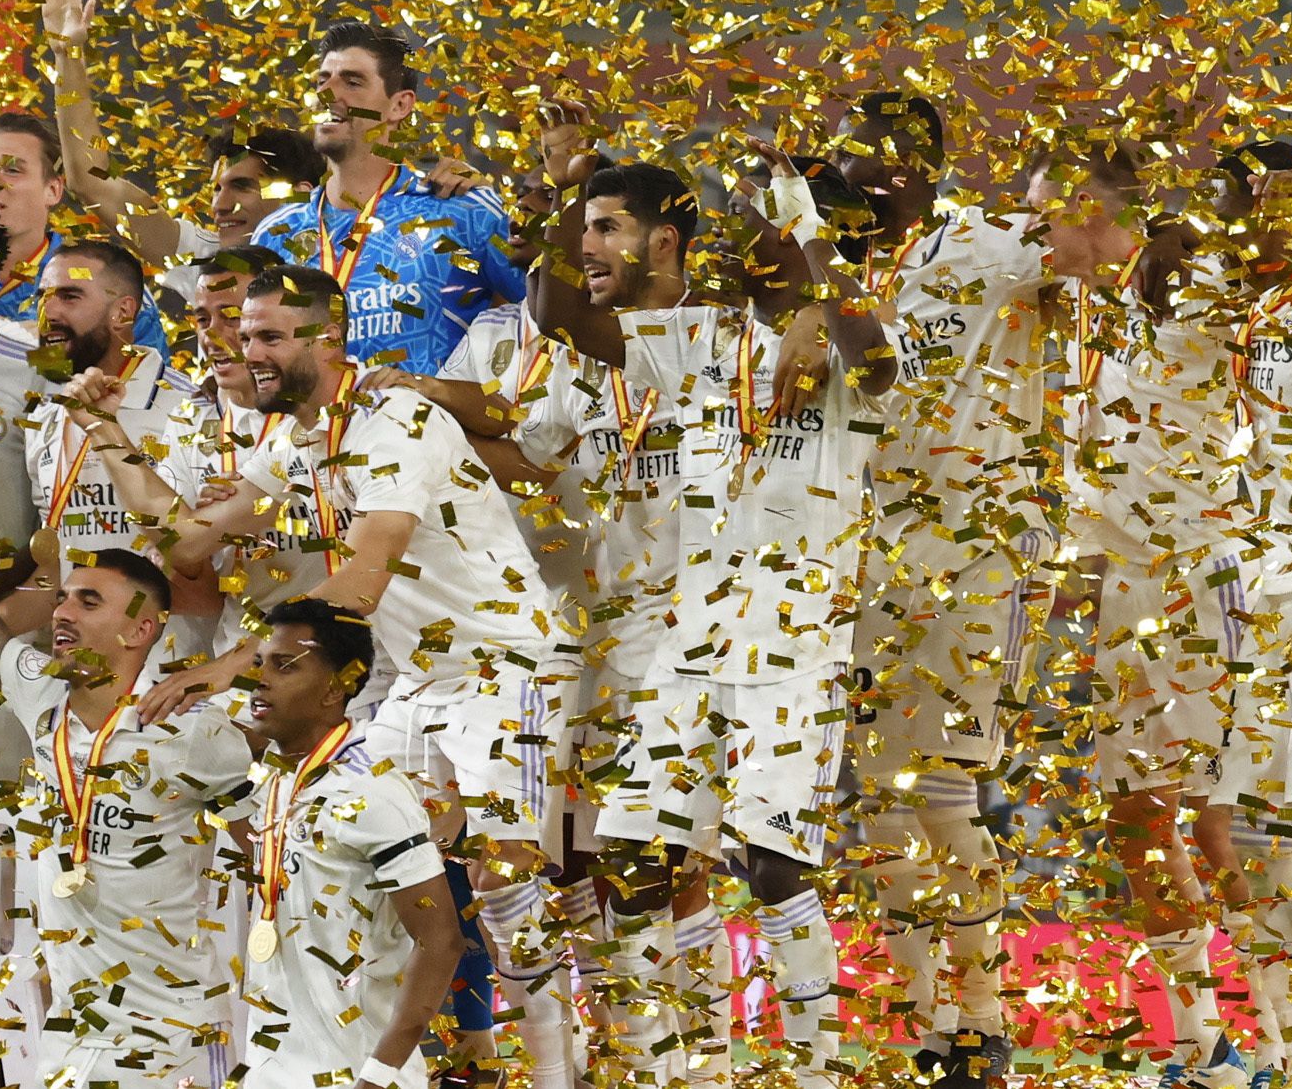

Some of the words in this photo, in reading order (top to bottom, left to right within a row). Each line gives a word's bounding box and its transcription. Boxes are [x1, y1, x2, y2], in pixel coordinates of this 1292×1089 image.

[348, 282, 422, 313] rates
[347, 311, 403, 342] BETTER
[766, 818, 794, 836] adidas
